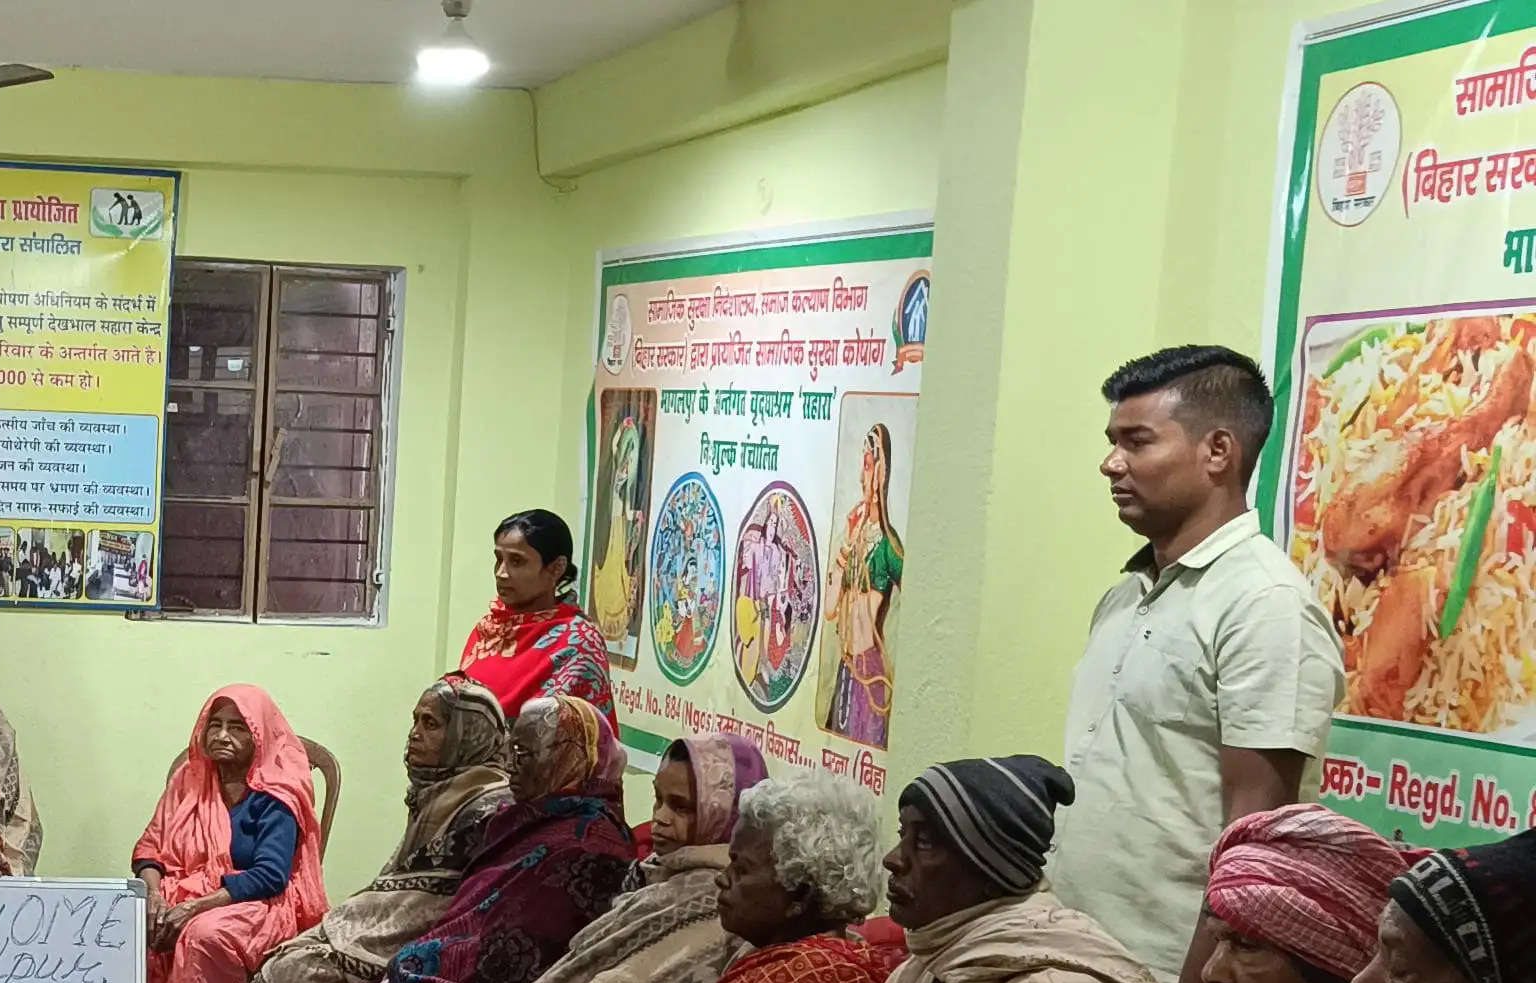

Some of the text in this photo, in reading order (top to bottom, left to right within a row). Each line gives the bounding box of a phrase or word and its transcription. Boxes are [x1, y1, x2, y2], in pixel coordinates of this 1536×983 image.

[13, 196, 79, 223] प्रायोजित
[19, 232, 82, 255] संचालित
[35, 291, 90, 309] अधिनियम
[95, 293, 107, 309] के
[112, 293, 141, 312] संदर्भ
[649, 290, 686, 322] सामाजिक
[688, 297, 710, 331] सुरक्षा
[761, 291, 789, 315] समाज
[792, 288, 830, 313] कल्याण
[832, 276, 868, 312] विभाग
[7, 313, 44, 335] सम्पूर्ण
[48, 317, 96, 333] देखभाल
[101, 319, 131, 335] सहारा
[136, 319, 161, 337] केन्द्र
[39, 344, 53, 359] के
[60, 343, 106, 361] अन्तर्गत
[112, 346, 141, 362] आते
[691, 343, 709, 370] द्वारा
[710, 330, 753, 370] प्रायोजित
[756, 329, 805, 366] सामाजिक
[808, 340, 840, 381] सुरक्षा
[843, 328, 886, 366] कोषांग
[32, 372, 44, 385] से
[49, 374, 74, 387] कम
[699, 382, 709, 414] के
[32, 417, 55, 432] जाँच
[60, 418, 74, 432] की
[45, 438, 60, 452] की
[19, 459, 33, 473] की
[1, 481, 27, 492] समय
[32, 483, 44, 492] पर
[50, 483, 78, 494] भ्रमण
[83, 482, 98, 495] की
[17, 500, 79, 516] साफ-सफाई
[84, 502, 98, 515] की
[620, 681, 642, 713] Regd.
[646, 688, 661, 715] No.
[1388, 764, 1462, 823] Regd.
[1471, 779, 1517, 829] No.
